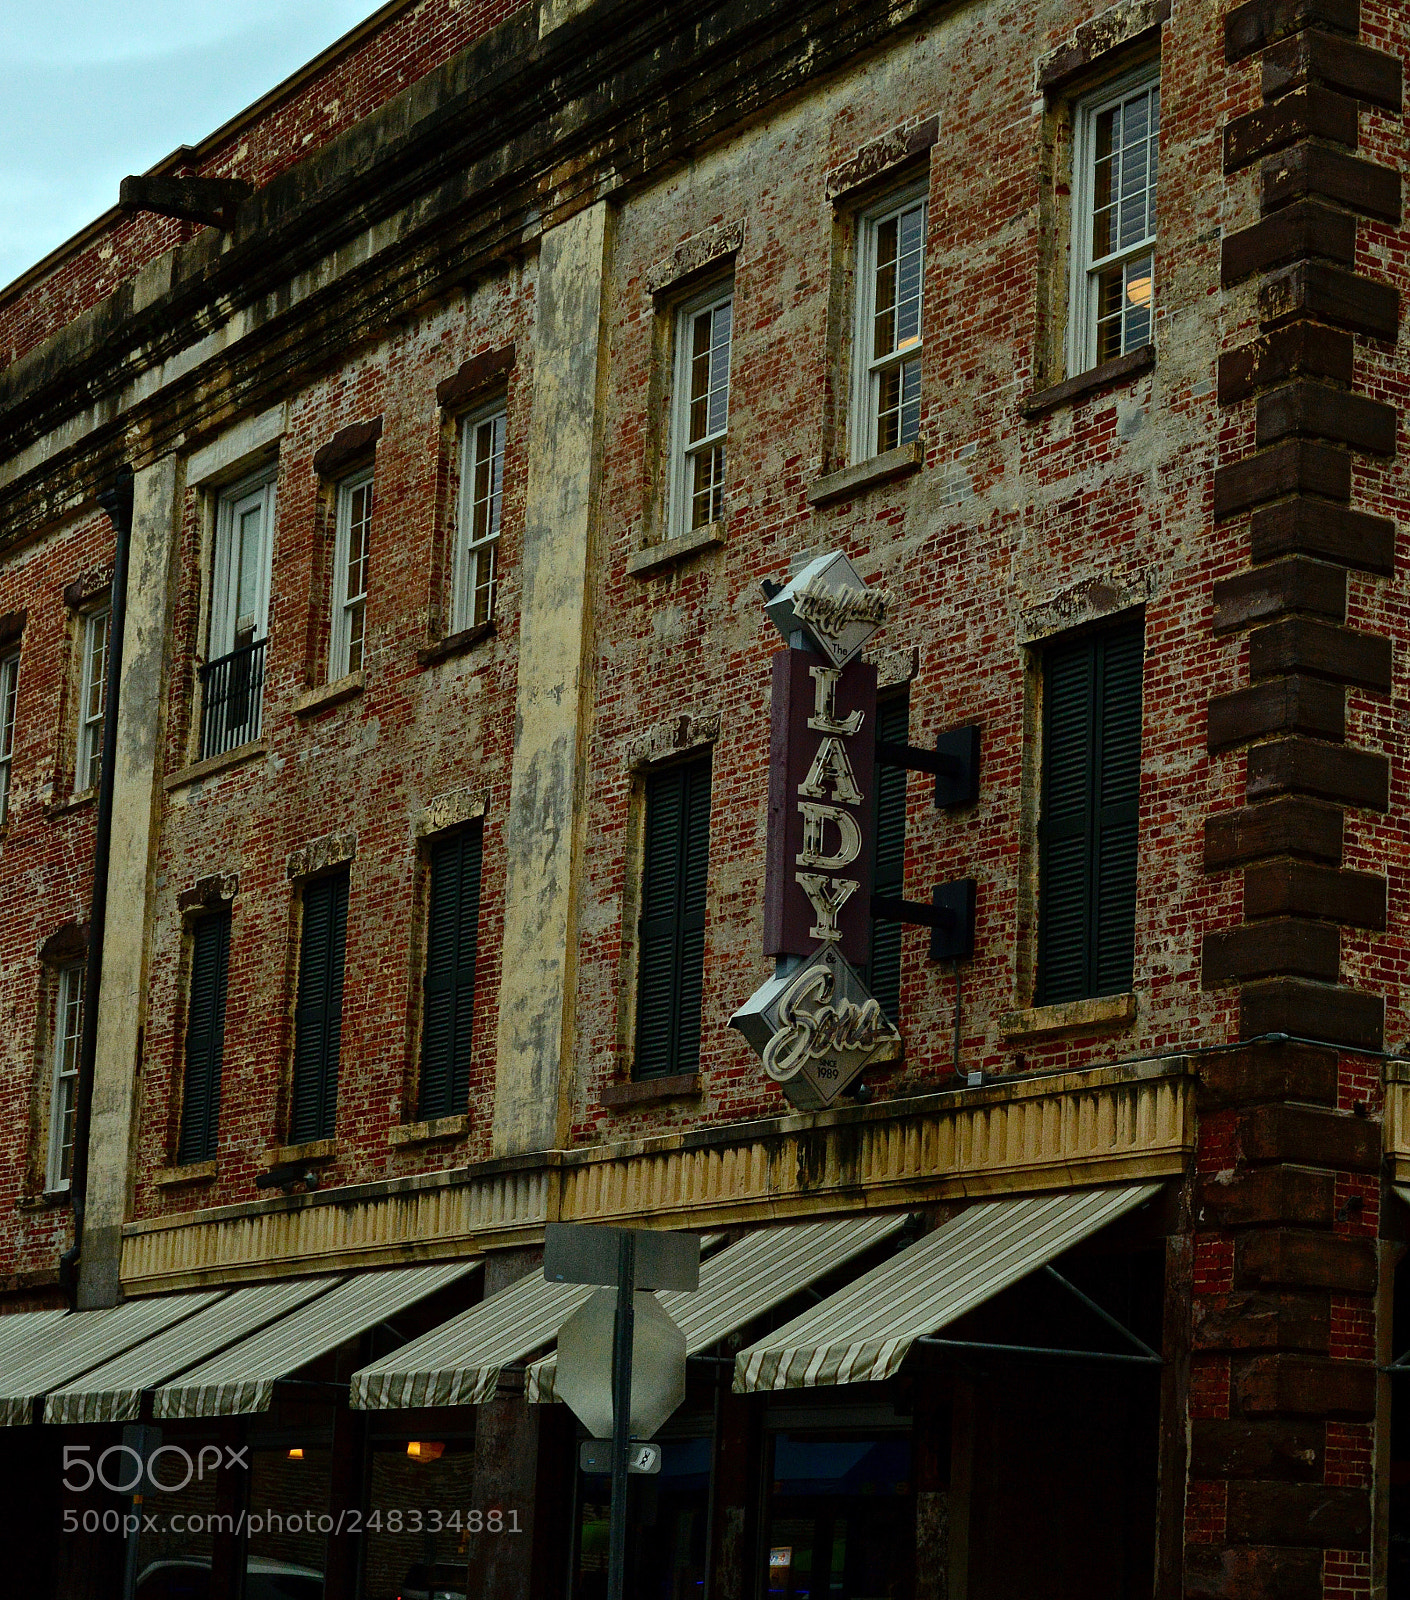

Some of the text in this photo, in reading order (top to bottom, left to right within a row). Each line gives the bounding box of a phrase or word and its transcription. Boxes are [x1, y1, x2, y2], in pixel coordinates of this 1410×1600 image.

[831, 643, 848, 656] The
[795, 665, 865, 941] LADY
[825, 952, 837, 964] &
[762, 965, 901, 1081] Sons
[819, 1059, 838, 1068] SINCE
[817, 1067, 839, 1080] 1989
